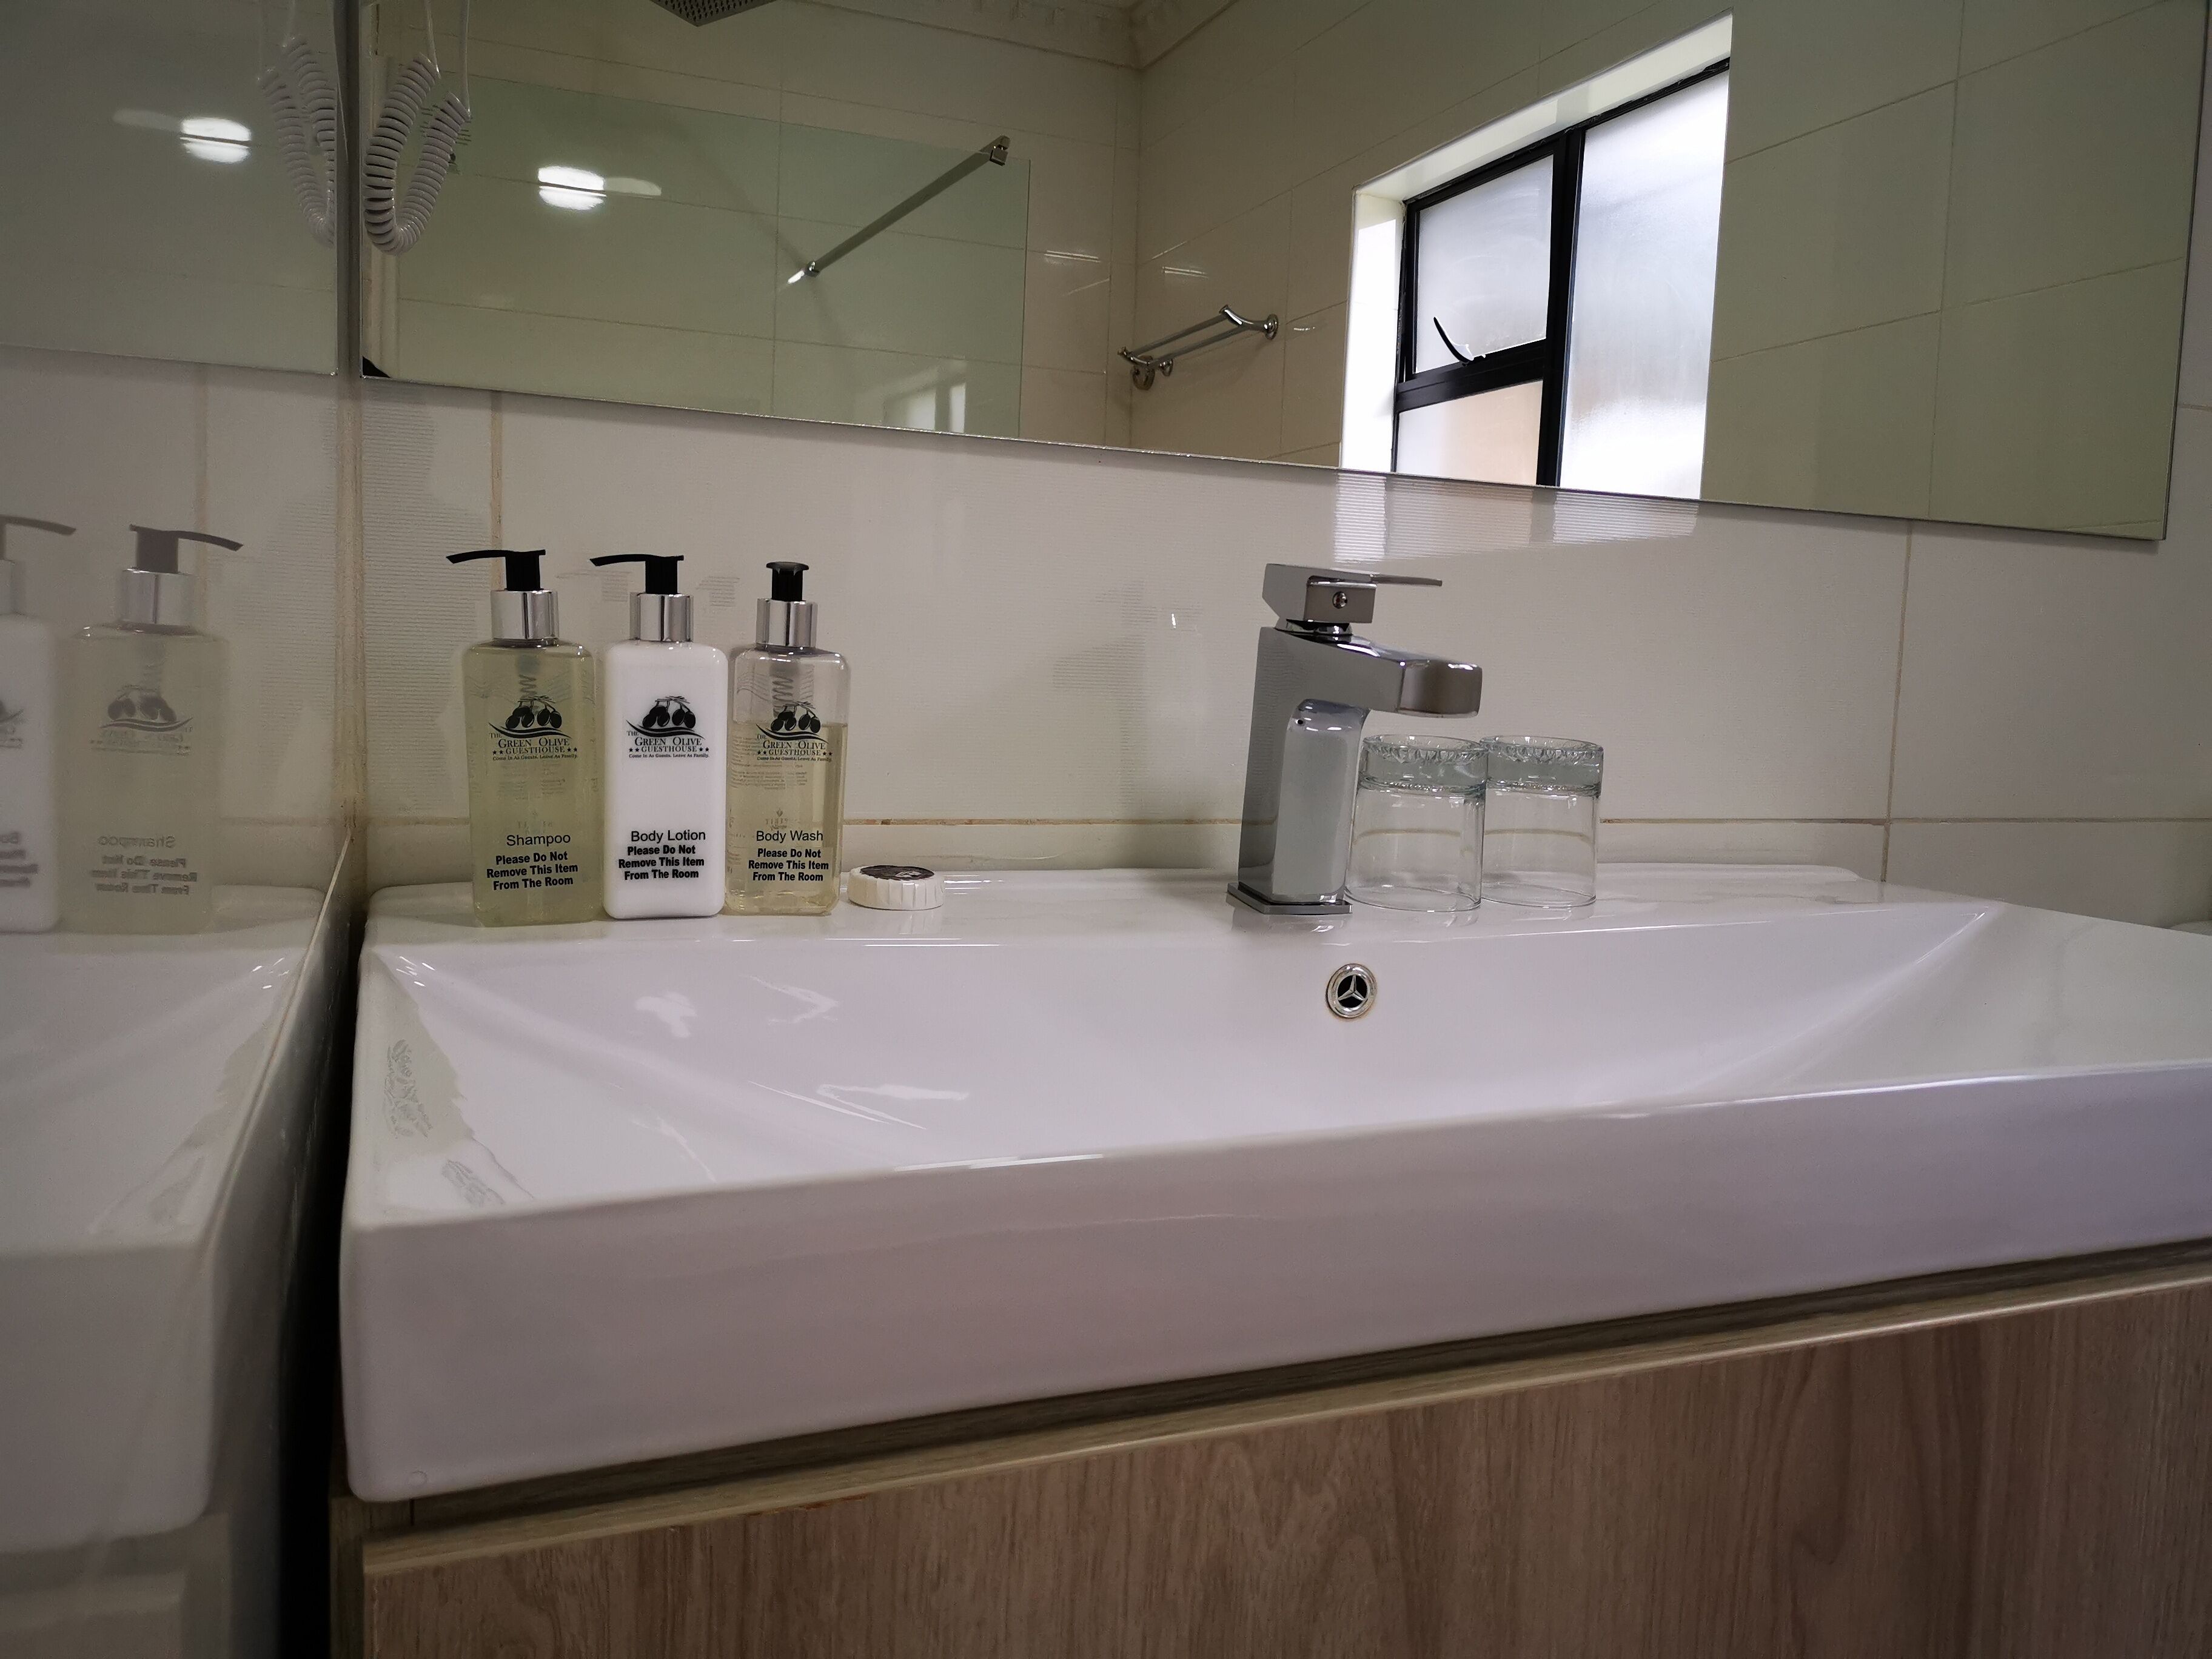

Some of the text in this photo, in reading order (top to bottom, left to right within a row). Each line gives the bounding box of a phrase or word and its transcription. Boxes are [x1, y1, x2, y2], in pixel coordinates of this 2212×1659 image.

[506, 746, 565, 755] GUESTHOUSE
[506, 834, 571, 847] Shampoo
[631, 829, 706, 844] Body Lotion
[756, 830, 823, 843] Body Wash
[627, 845, 695, 856] Please Do Not
[757, 848, 821, 858] Please Do Not
[495, 851, 568, 865] Please Do Not
[618, 857, 704, 868] Remove This Item
[486, 863, 578, 878] Remove This Item
[748, 860, 829, 870] Remove This Item
[625, 869, 699, 880] From The Room
[752, 872, 823, 881] From The Room
[493, 877, 574, 890] From The Room
